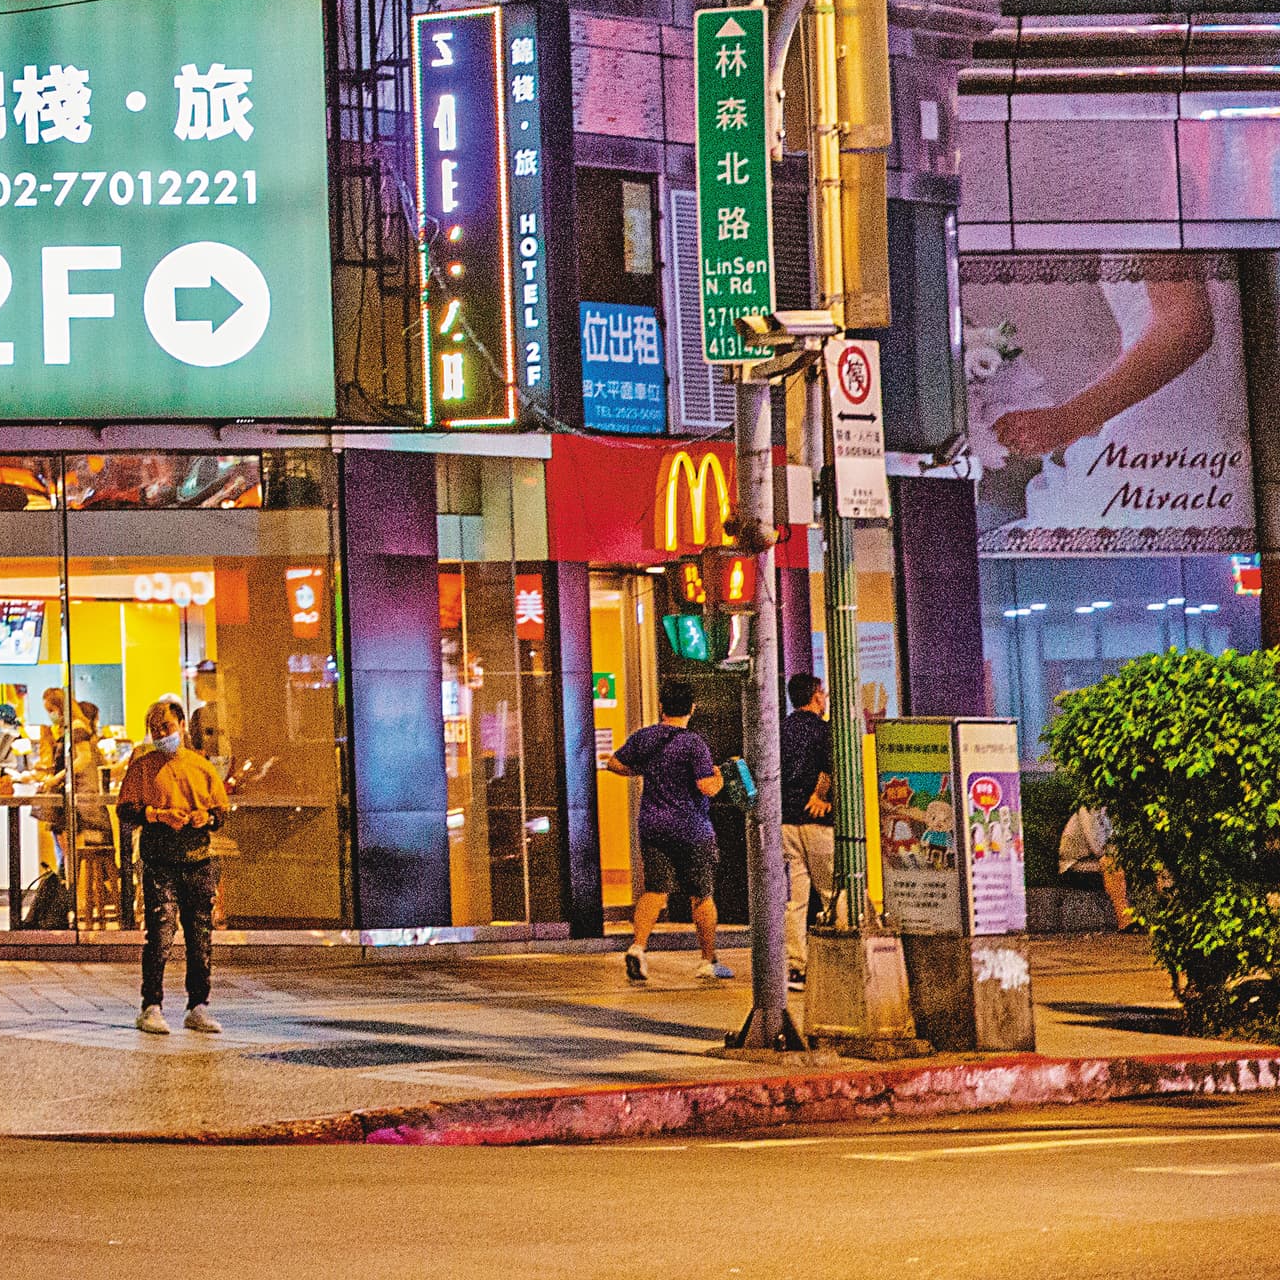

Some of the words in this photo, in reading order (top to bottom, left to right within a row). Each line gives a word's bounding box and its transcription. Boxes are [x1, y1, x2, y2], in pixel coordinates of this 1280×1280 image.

[714, 42, 750, 242] 林森北路
[518, 213, 539, 329] HOTEL
[704, 256, 768, 275] LinSen
[705, 277, 723, 295] N.
[729, 274, 757, 295] Rd.
[582, 309, 661, 366] 位出租
[524, 341, 541, 388] 2F
[1086, 441, 1242, 478] Marriage
[1100, 481, 1234, 517] Miracle
[515, 589, 544, 625] 美
